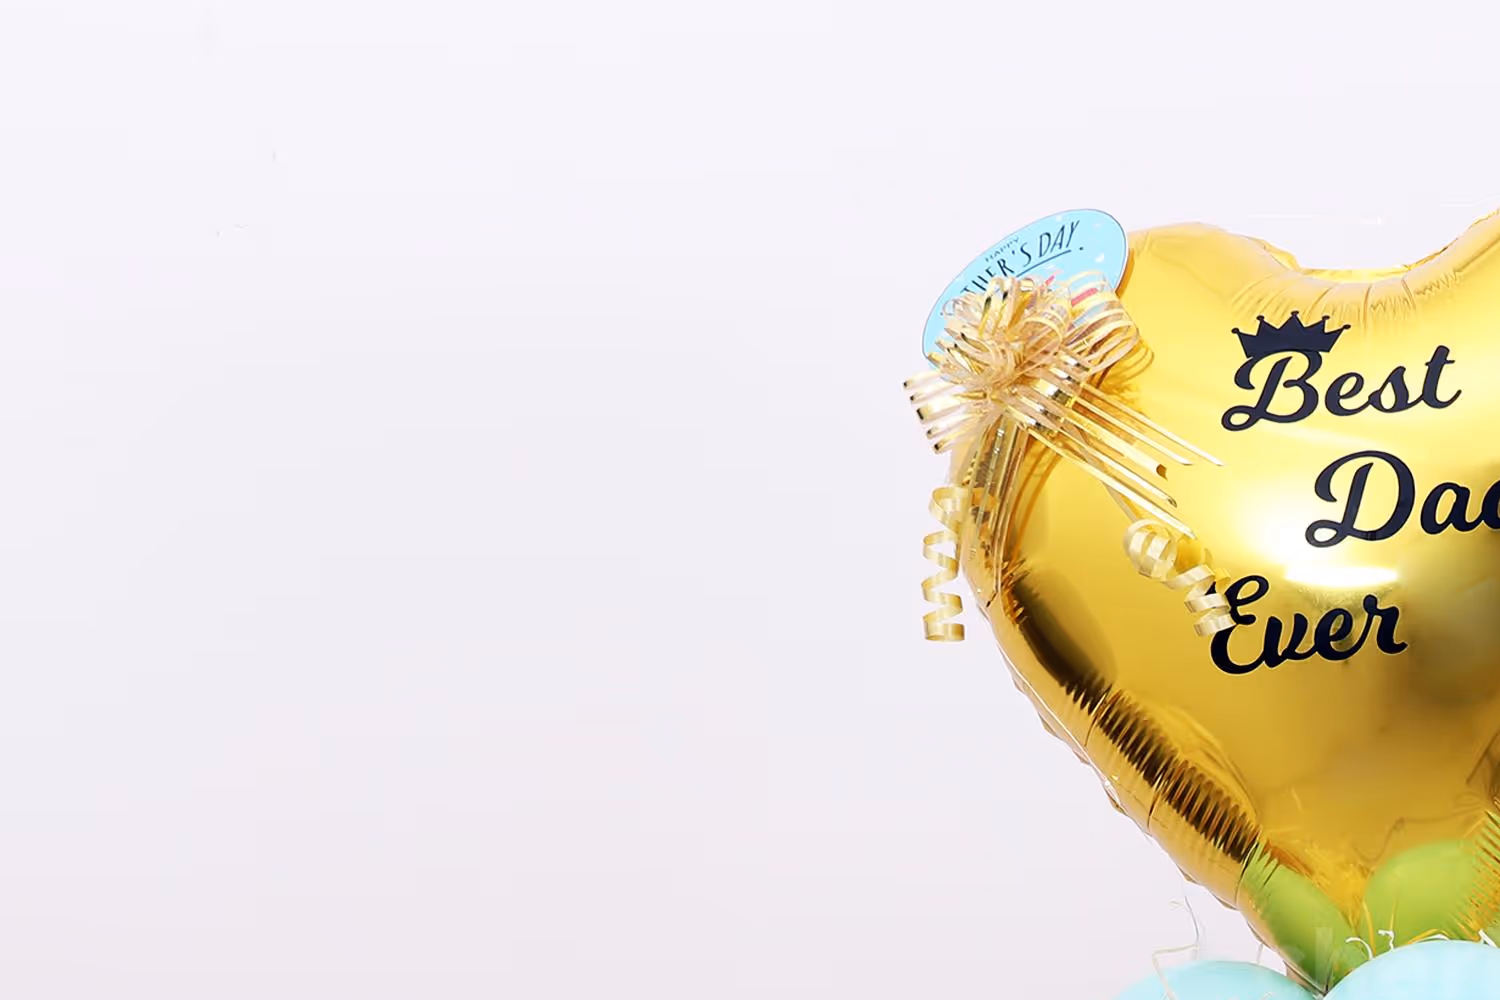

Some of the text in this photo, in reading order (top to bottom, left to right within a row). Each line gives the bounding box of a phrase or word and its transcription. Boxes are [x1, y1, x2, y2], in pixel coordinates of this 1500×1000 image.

[959, 242, 1032, 295] THER'S
[1220, 345, 1463, 432] Best
[1203, 574, 1409, 675] Ever
